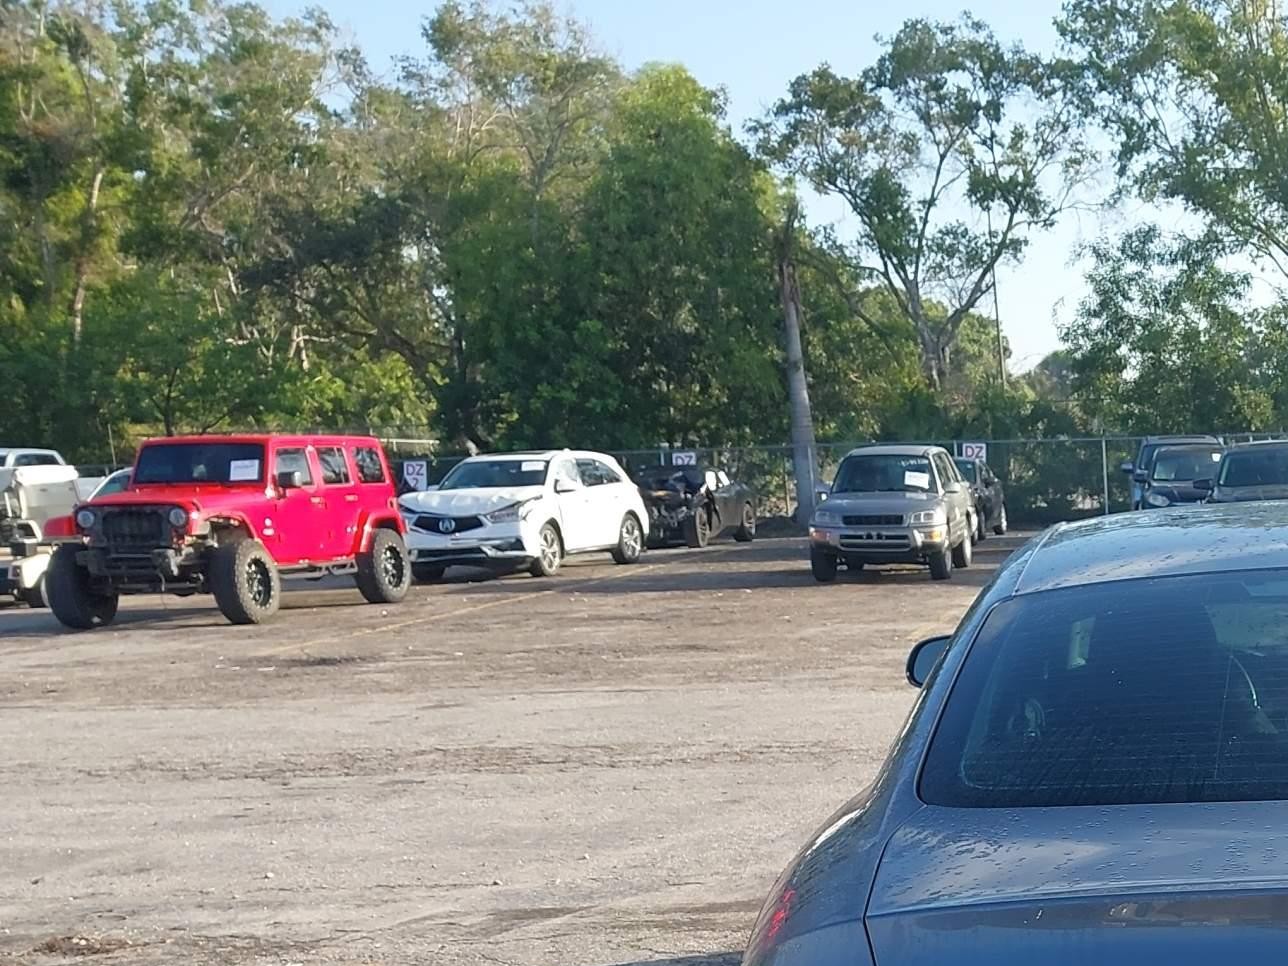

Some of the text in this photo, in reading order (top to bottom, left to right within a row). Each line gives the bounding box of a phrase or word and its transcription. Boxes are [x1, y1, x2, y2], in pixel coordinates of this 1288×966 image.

[965, 445, 984, 459] DZ
[674, 455, 693, 465] DZ
[406, 463, 424, 476] DZ
